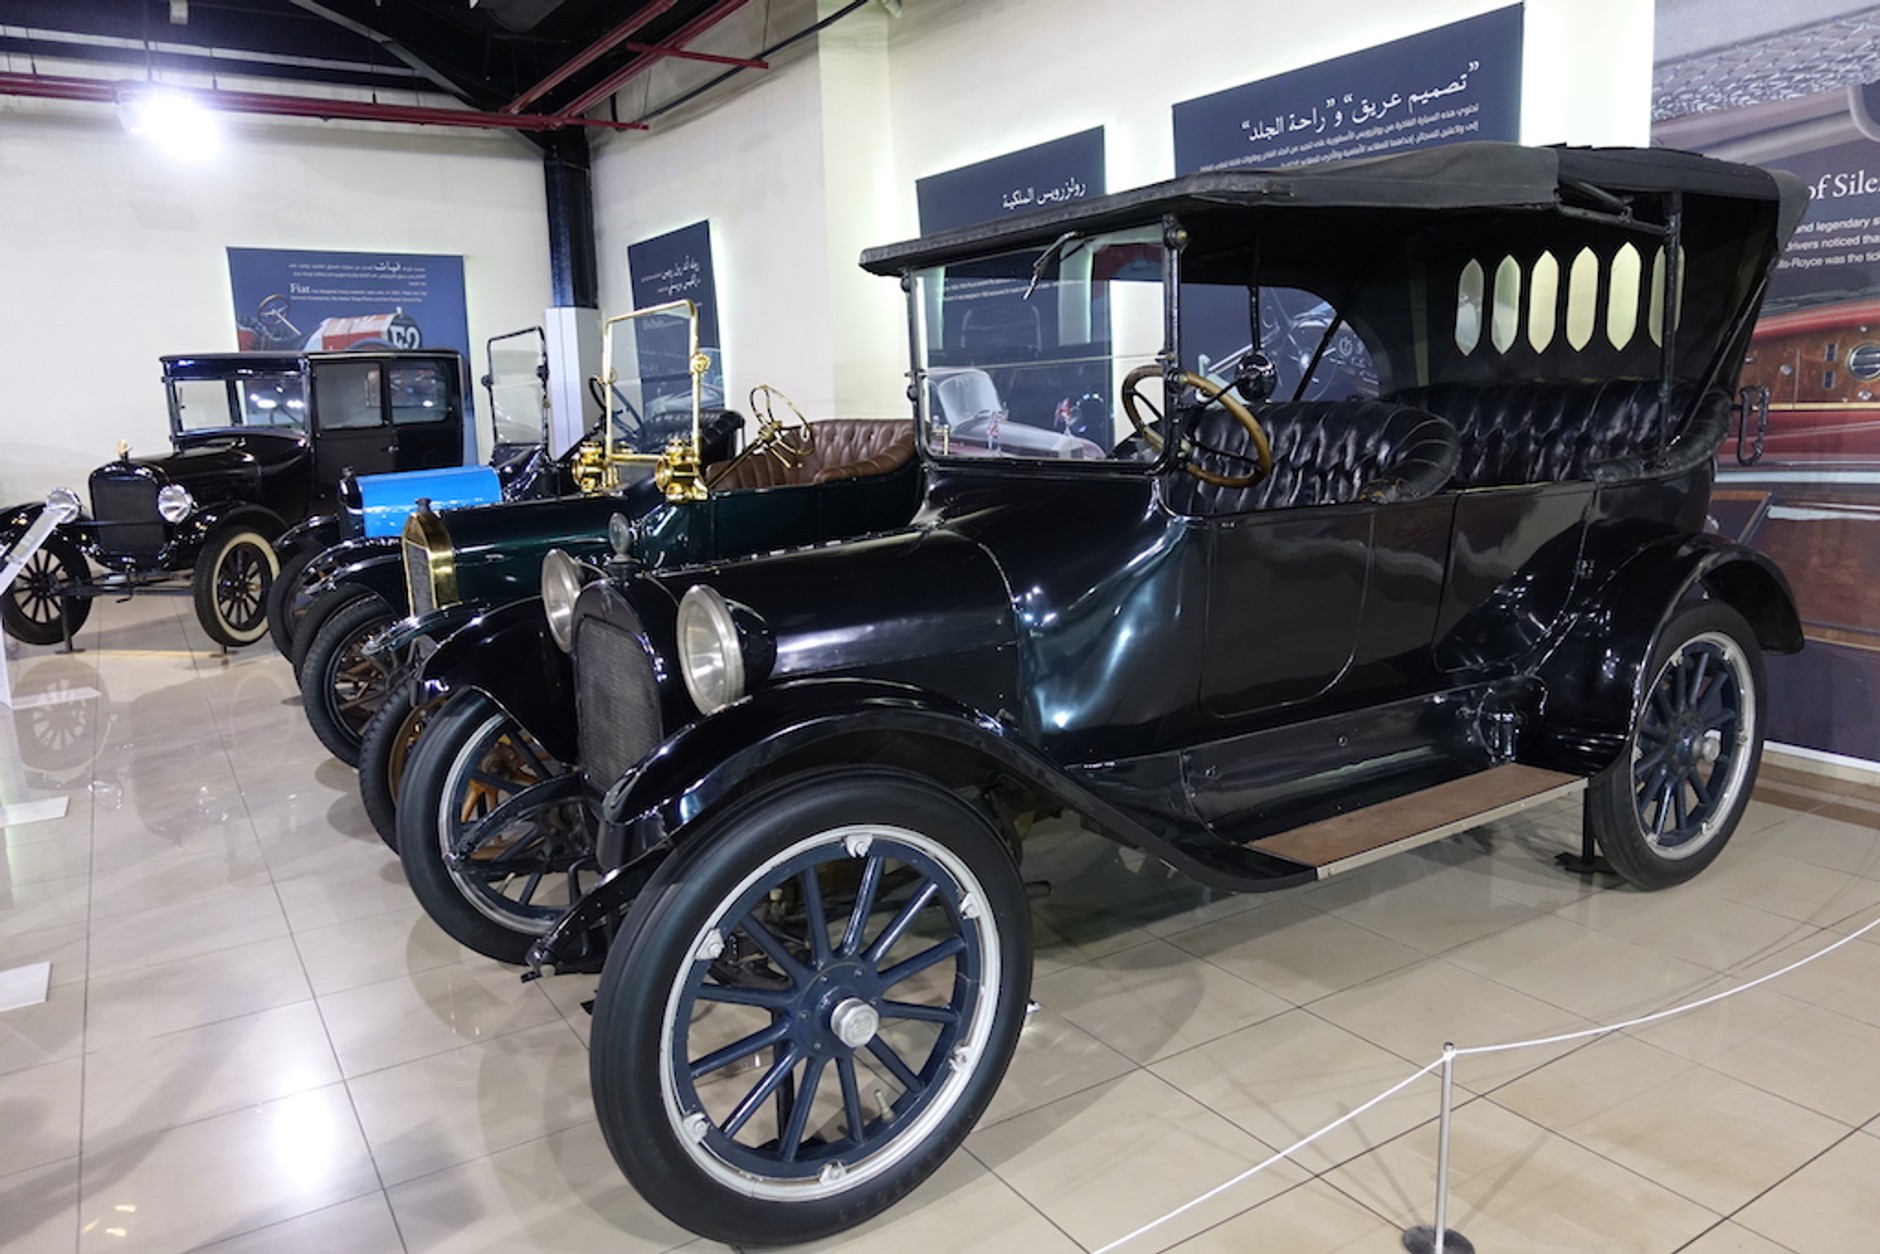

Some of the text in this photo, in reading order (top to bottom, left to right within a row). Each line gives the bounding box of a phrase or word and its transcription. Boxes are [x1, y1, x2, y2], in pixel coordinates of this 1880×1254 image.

[1832, 169, 1880, 198] Sile
[1816, 217, 1871, 233] legendary
[1821, 235, 1861, 248] noticed
[1825, 254, 1846, 265] was
[1847, 252, 1865, 263] the
[289, 282, 310, 294] Fiat
